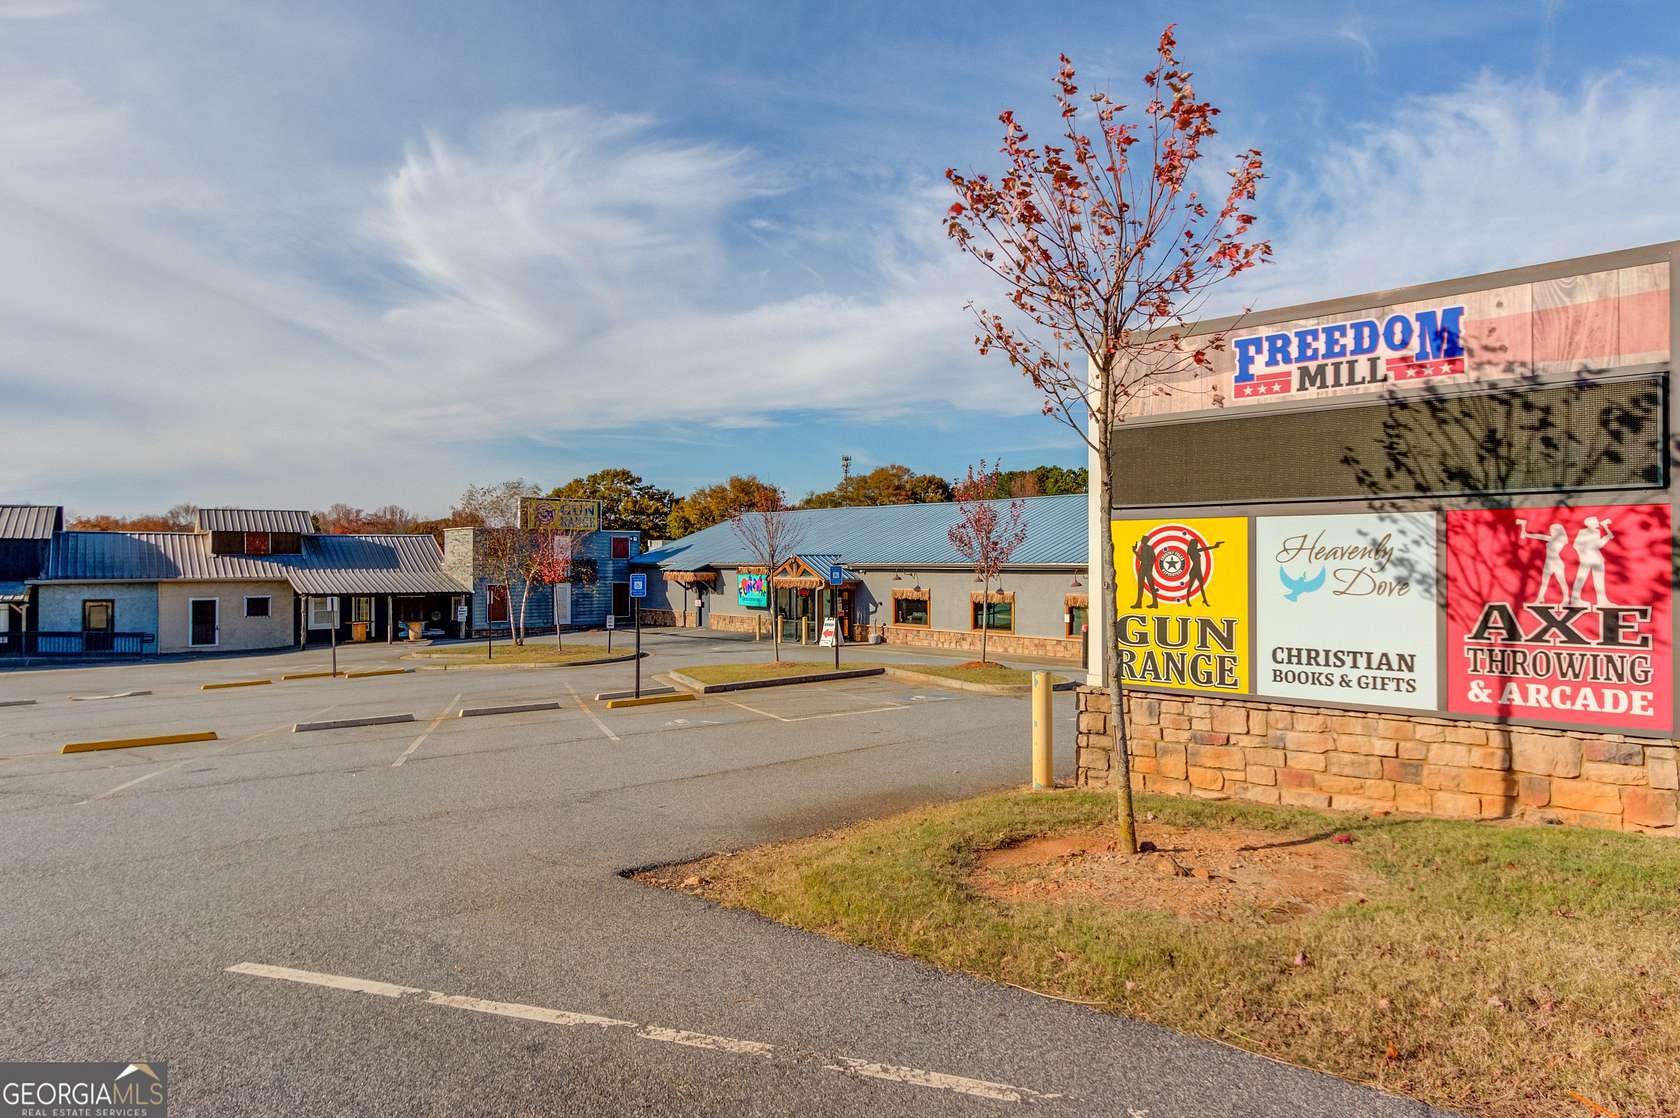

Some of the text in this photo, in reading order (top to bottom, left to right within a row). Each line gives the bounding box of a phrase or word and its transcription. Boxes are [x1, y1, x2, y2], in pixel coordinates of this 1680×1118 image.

[1234, 306, 1465, 384] FREEDOM
[1297, 357, 1388, 392] MILL
[1276, 530, 1395, 573] Heavenly
[1333, 567, 1410, 598] Dove
[1117, 614, 1238, 652] GUN
[1465, 602, 1653, 647] AXE
[1120, 648, 1240, 689] RANGE
[1272, 646, 1416, 673] CHRISTIAN
[1465, 647, 1653, 685] THROWING
[1272, 669, 1417, 694] BOOKS & GIFTS
[1467, 680, 1655, 716] & ARCADE
